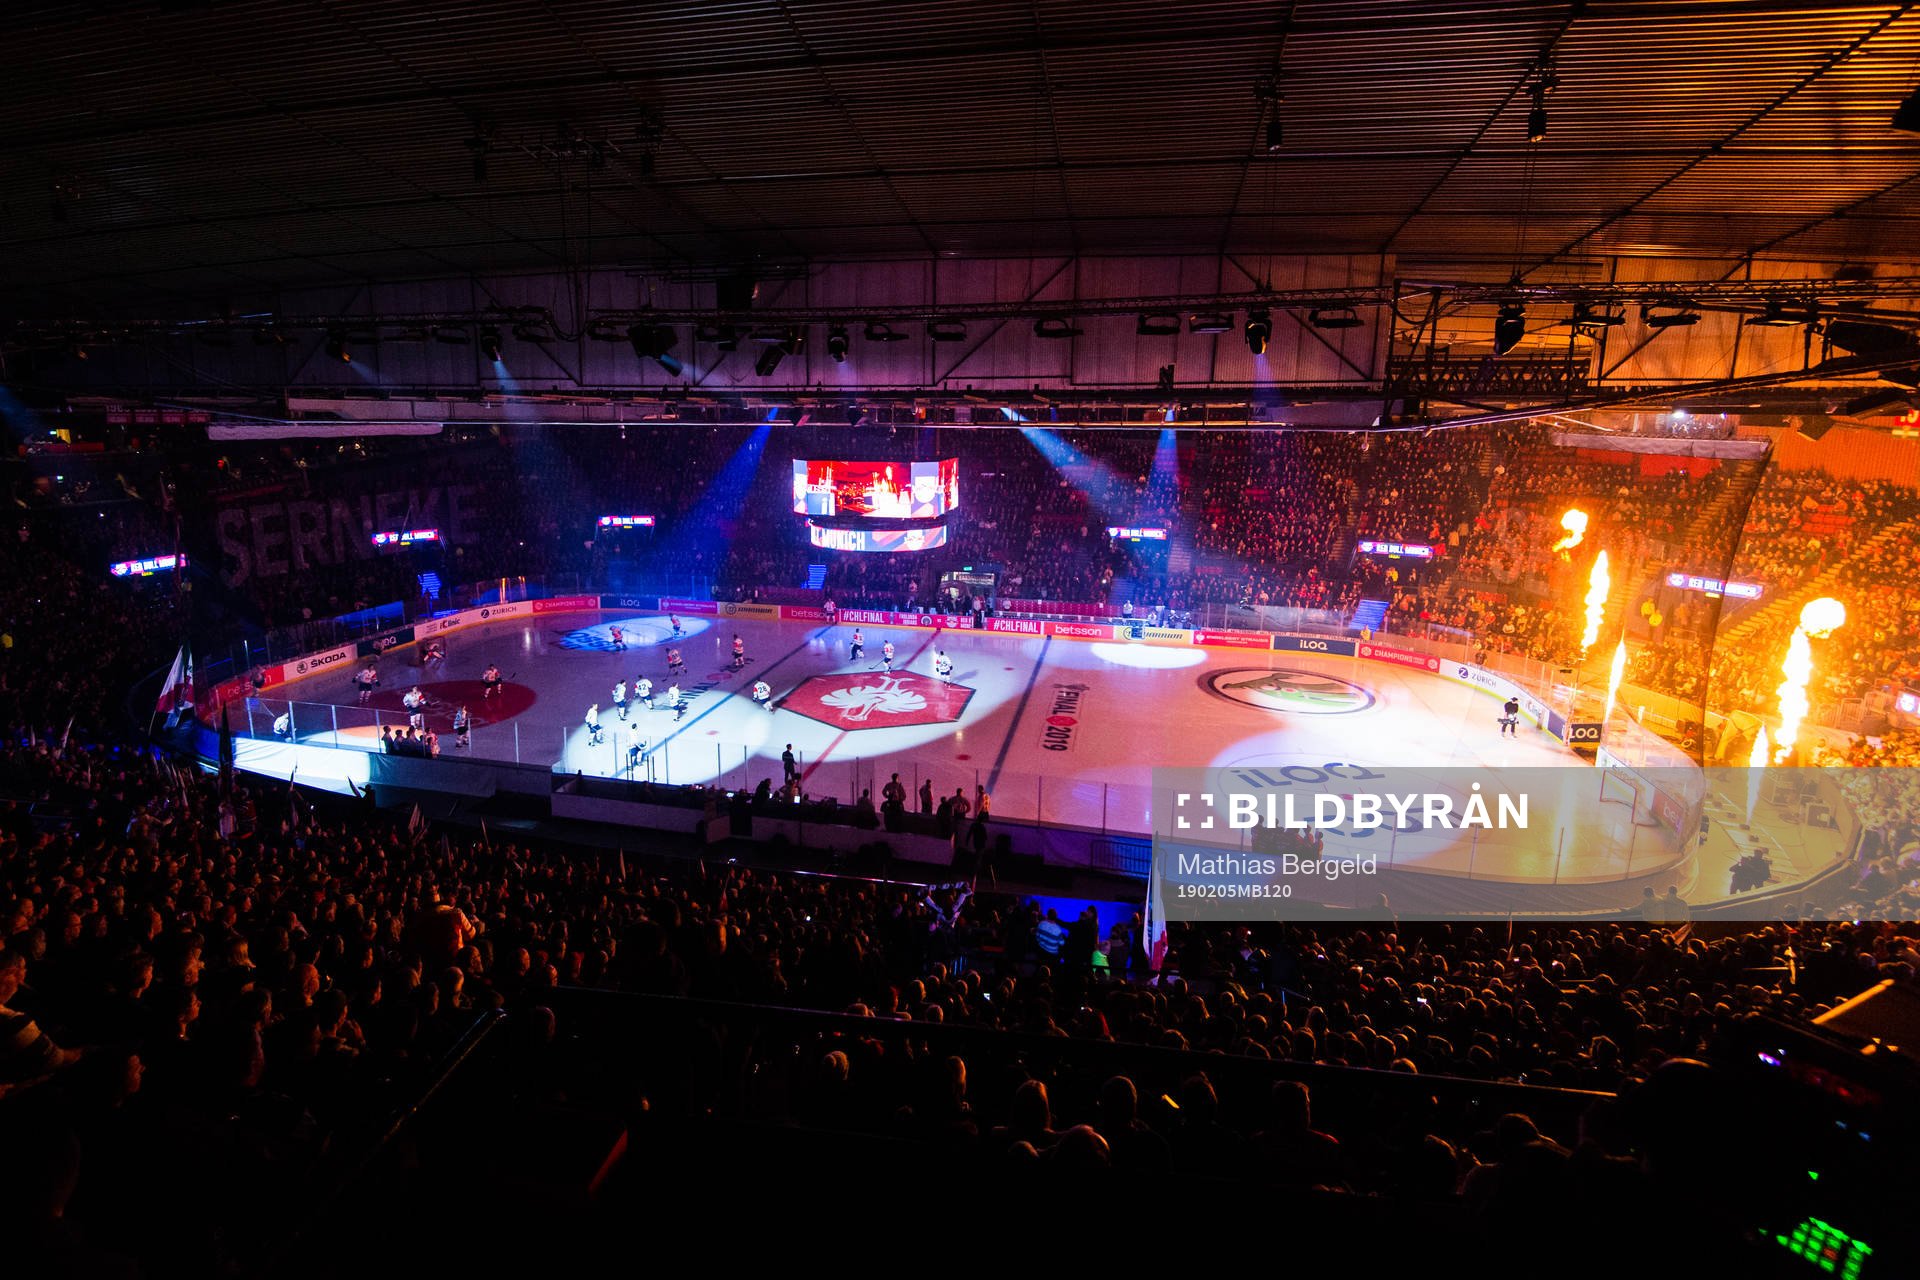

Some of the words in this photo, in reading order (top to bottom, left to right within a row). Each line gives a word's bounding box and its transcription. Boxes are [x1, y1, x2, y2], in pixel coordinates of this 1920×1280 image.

[216, 484, 486, 588] SERNEKE
[822, 531, 865, 550] MUNICH
[844, 610, 884, 624] #CHLFINAL
[994, 620, 1038, 633] #CHLFINAL
[1055, 625, 1102, 636] betsson
[1300, 640, 1328, 650] iLOQ
[310, 652, 346, 668] ŠKODA
[1374, 650, 1413, 663] CHAMPIONS
[758, 685, 768, 694] 28
[1052, 690, 1080, 714] FINAL
[1042, 726, 1072, 751] 2019
[1230, 762, 1386, 788] iLOQ
